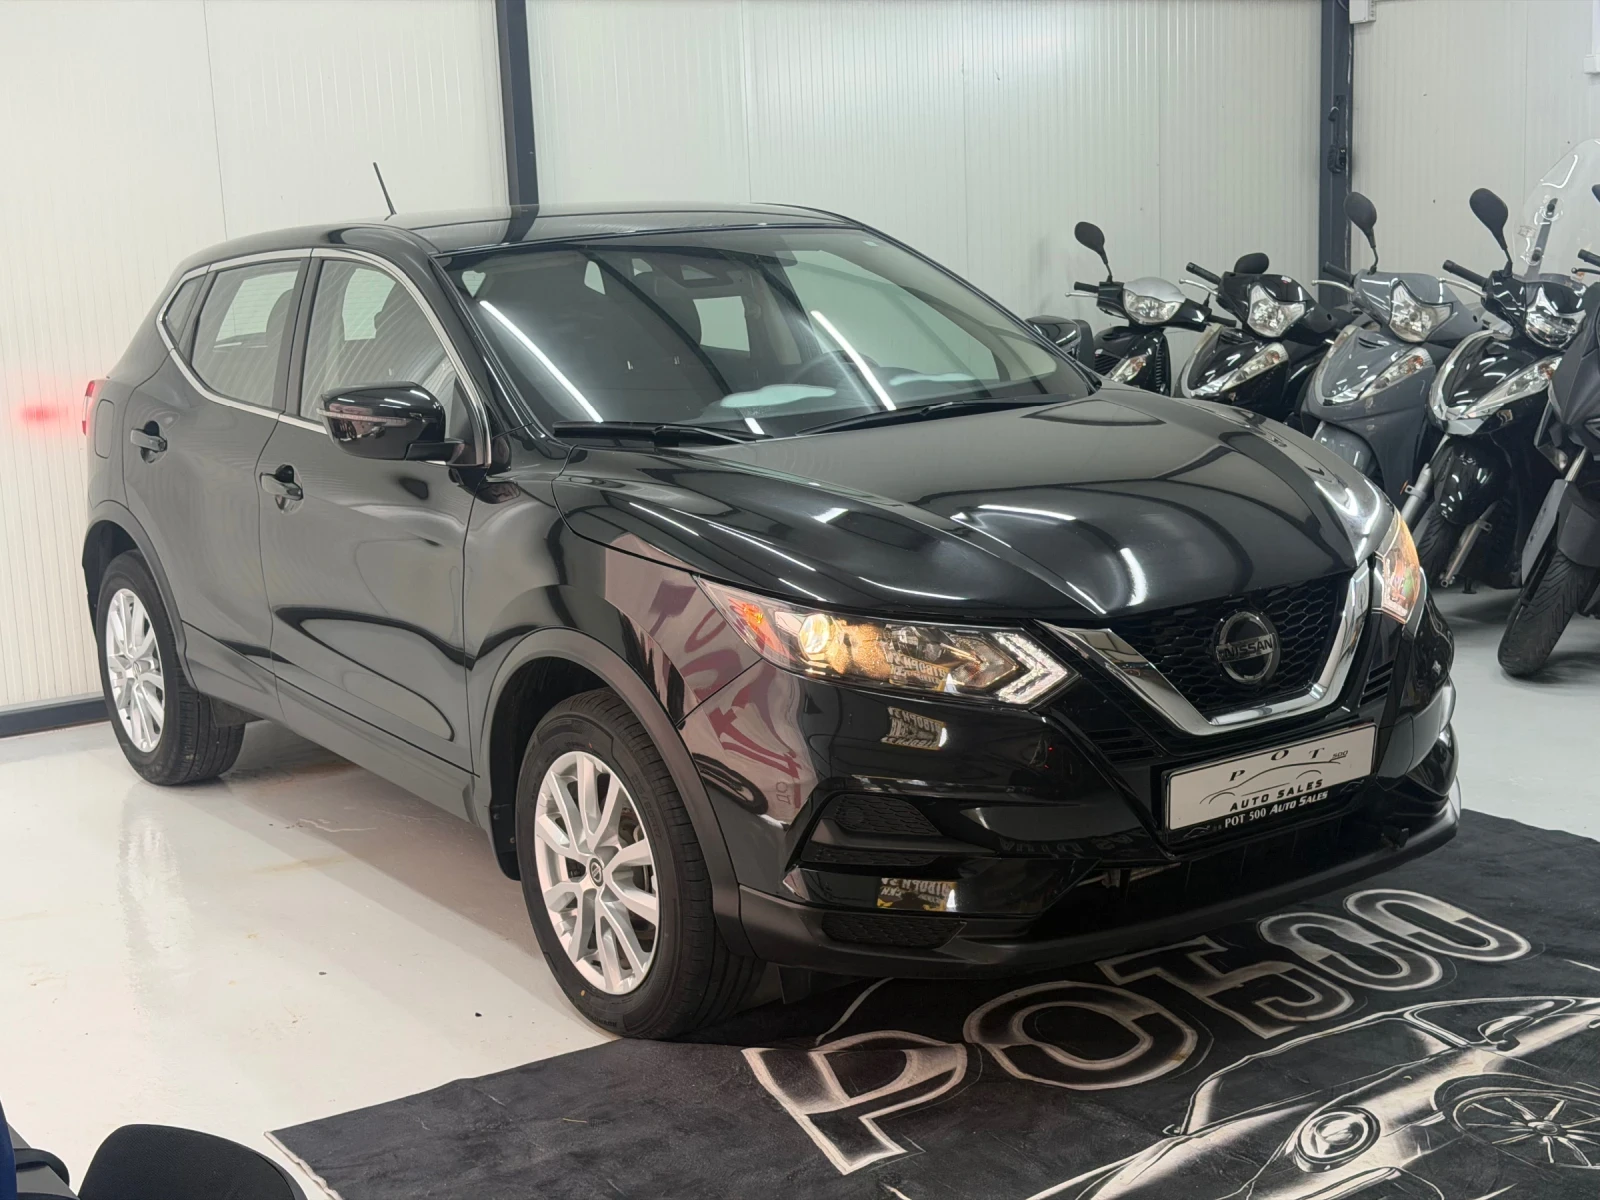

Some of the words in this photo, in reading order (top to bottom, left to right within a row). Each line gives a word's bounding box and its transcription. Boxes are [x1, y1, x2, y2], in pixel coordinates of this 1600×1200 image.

[1224, 638, 1273, 658] NISSAN
[1332, 750, 1349, 759] 500
[1229, 794, 1270, 812] AUTO
[1276, 778, 1323, 799] SALES
[1224, 815, 1245, 829] POT
[1249, 808, 1266, 822] 500
